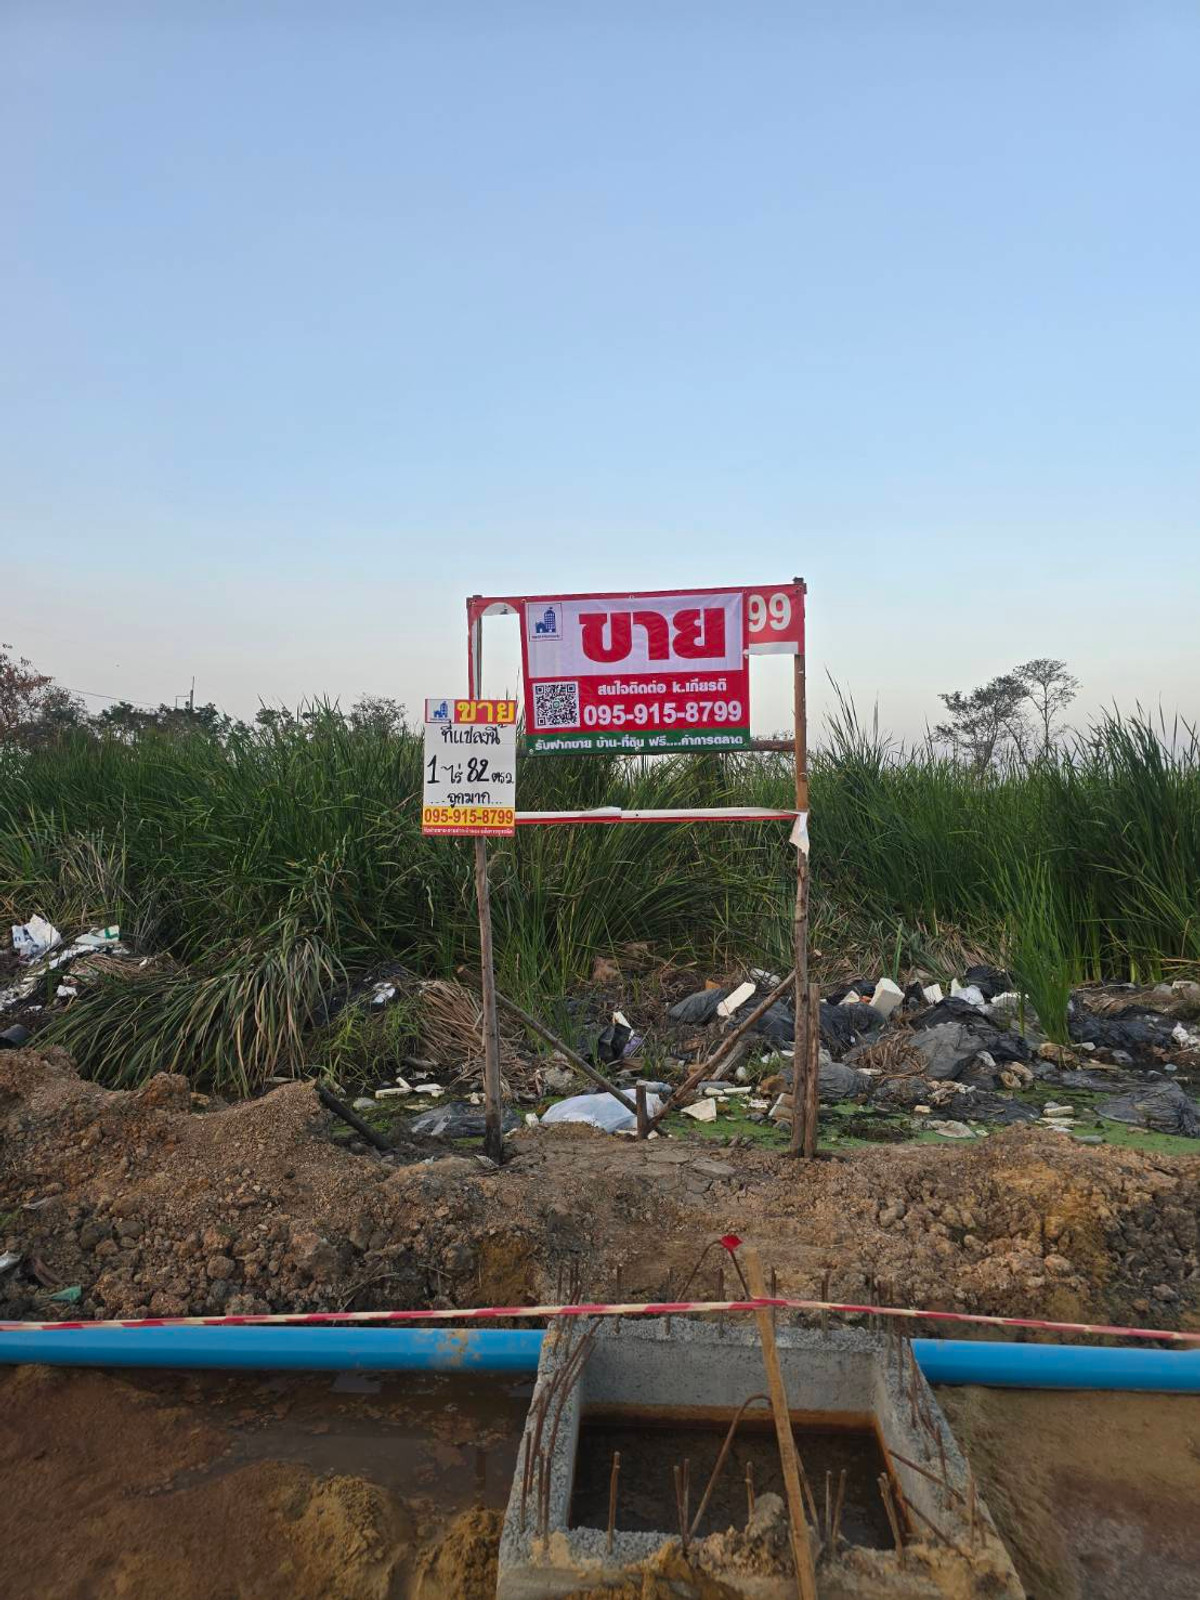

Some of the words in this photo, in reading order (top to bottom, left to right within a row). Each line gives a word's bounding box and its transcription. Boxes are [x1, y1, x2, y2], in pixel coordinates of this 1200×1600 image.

[579, 607, 726, 663] ขาย
[597, 680, 667, 696] สนใจติดต่อ
[457, 700, 515, 723] ขาย
[583, 700, 742, 726] 095-915-8799
[535, 739, 592, 751] รับฝากขาย
[596, 737, 645, 749] บ้าน-ที่ดิน
[427, 754, 440, 784] 1
[441, 763, 463, 784] ไร่
[467, 757, 490, 783] 82
[424, 808, 514, 824] 095-915-8799
